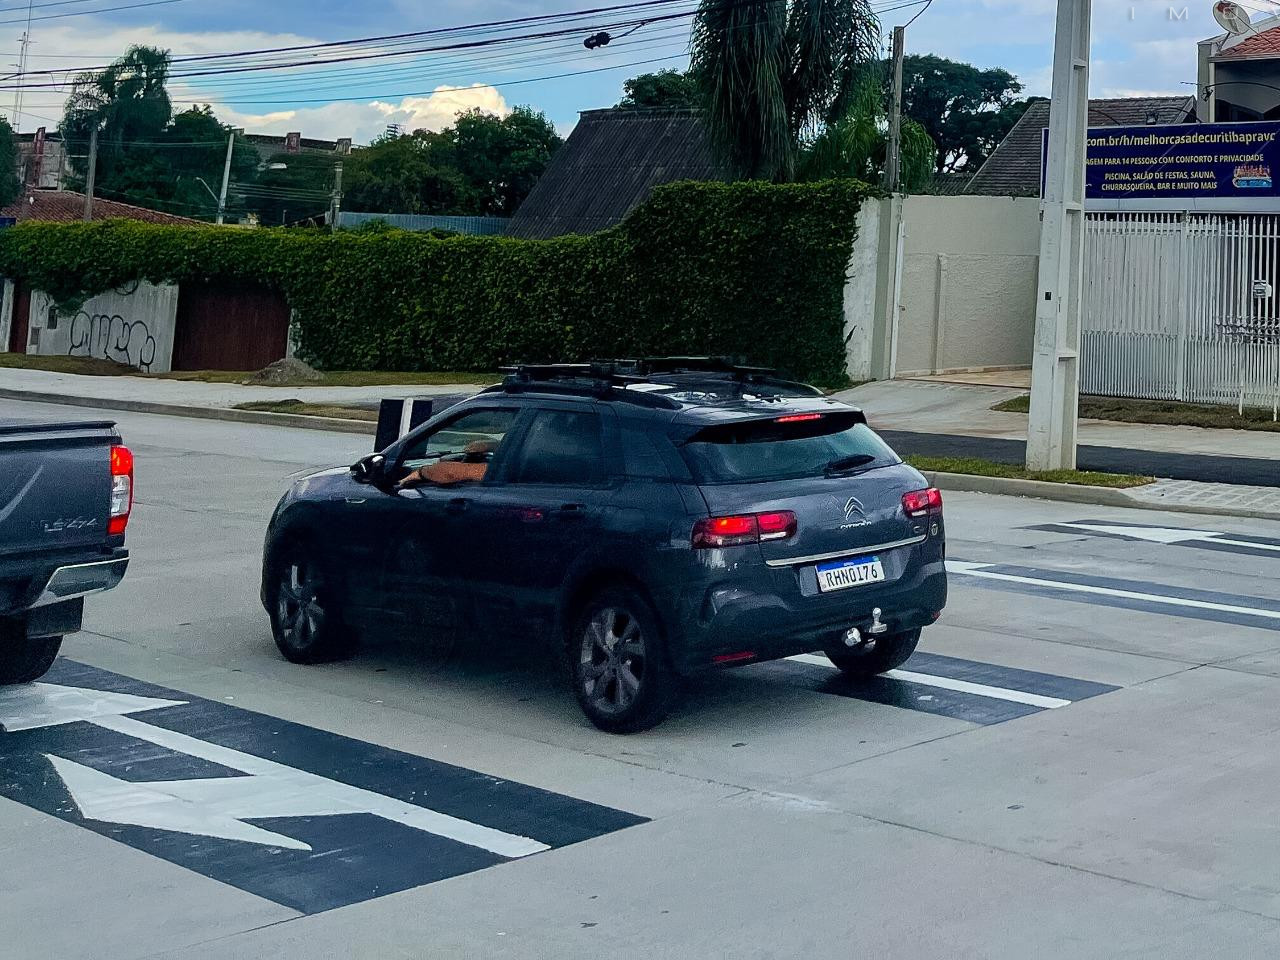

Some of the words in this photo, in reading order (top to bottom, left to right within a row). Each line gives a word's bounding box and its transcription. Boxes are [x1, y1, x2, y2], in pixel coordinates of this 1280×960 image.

[1175, 155, 1212, 163] CONFORTO
[1219, 154, 1264, 162] PRIVACIDADE
[1200, 181, 1218, 189] MAIS
